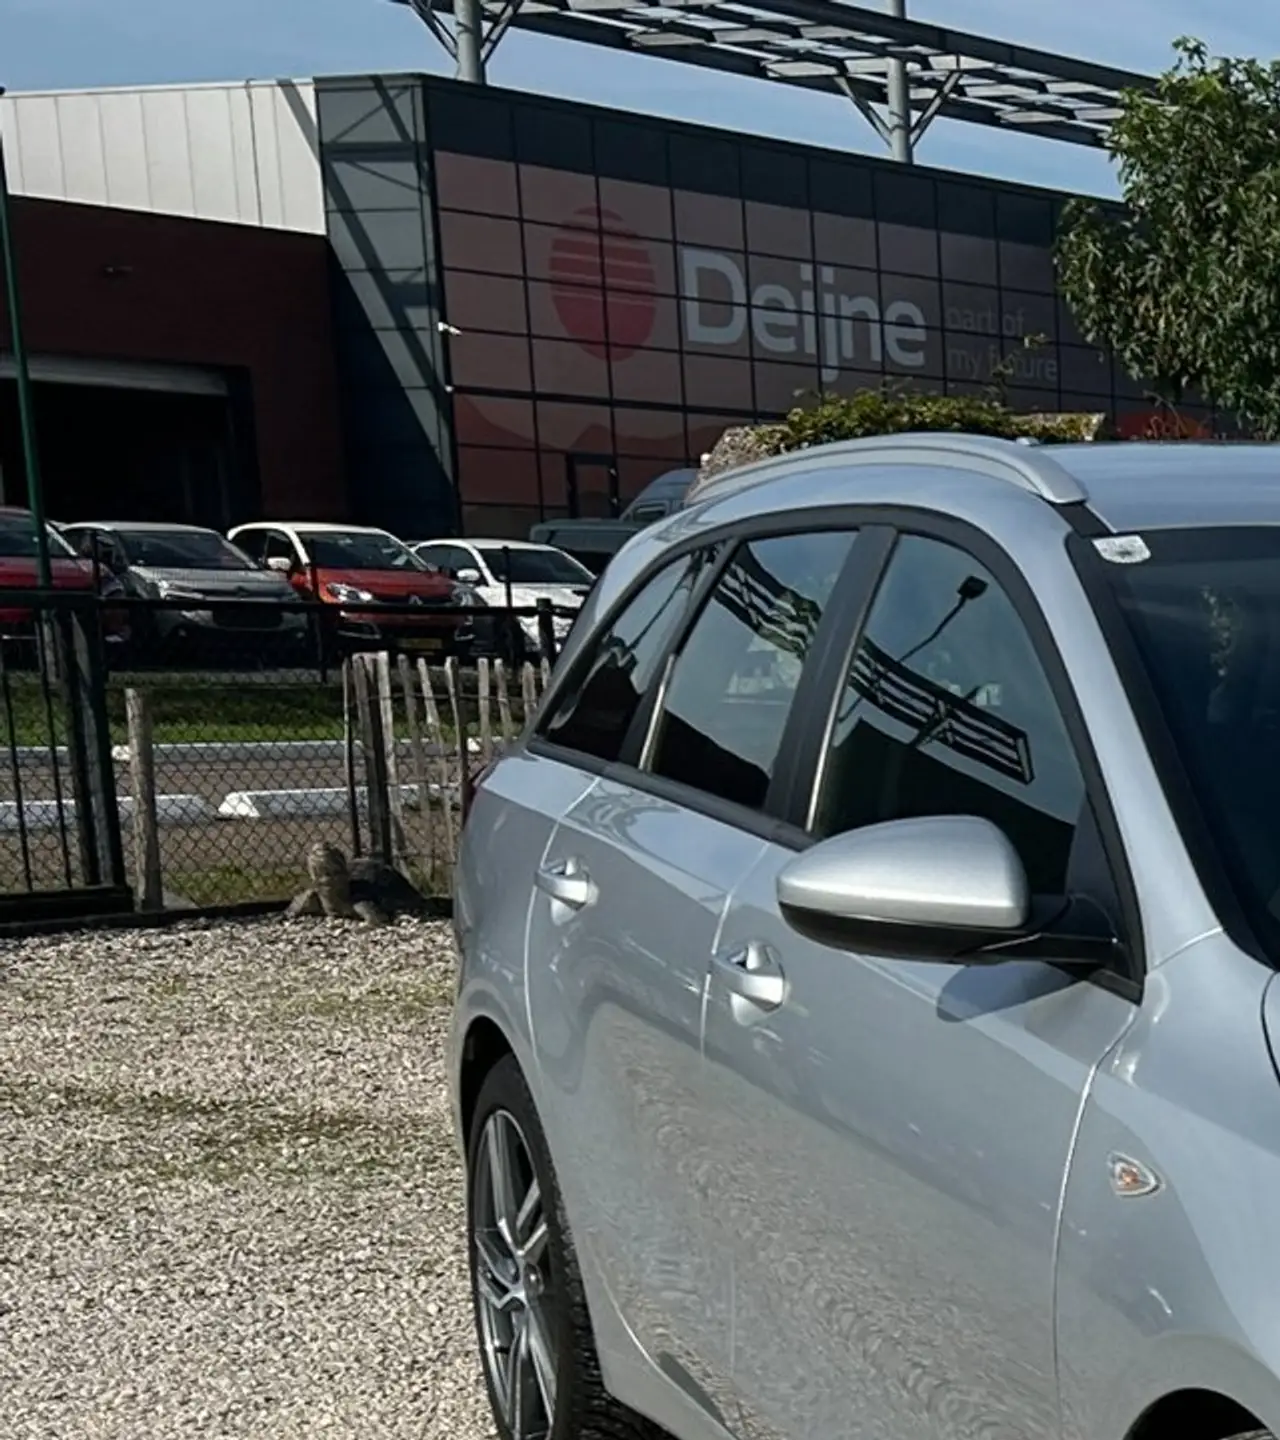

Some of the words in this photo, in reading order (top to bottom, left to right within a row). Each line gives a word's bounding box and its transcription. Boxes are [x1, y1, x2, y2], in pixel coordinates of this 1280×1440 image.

[681, 247, 928, 383] Deijne
[1003, 306, 1025, 337] of
[946, 347, 983, 380] my
